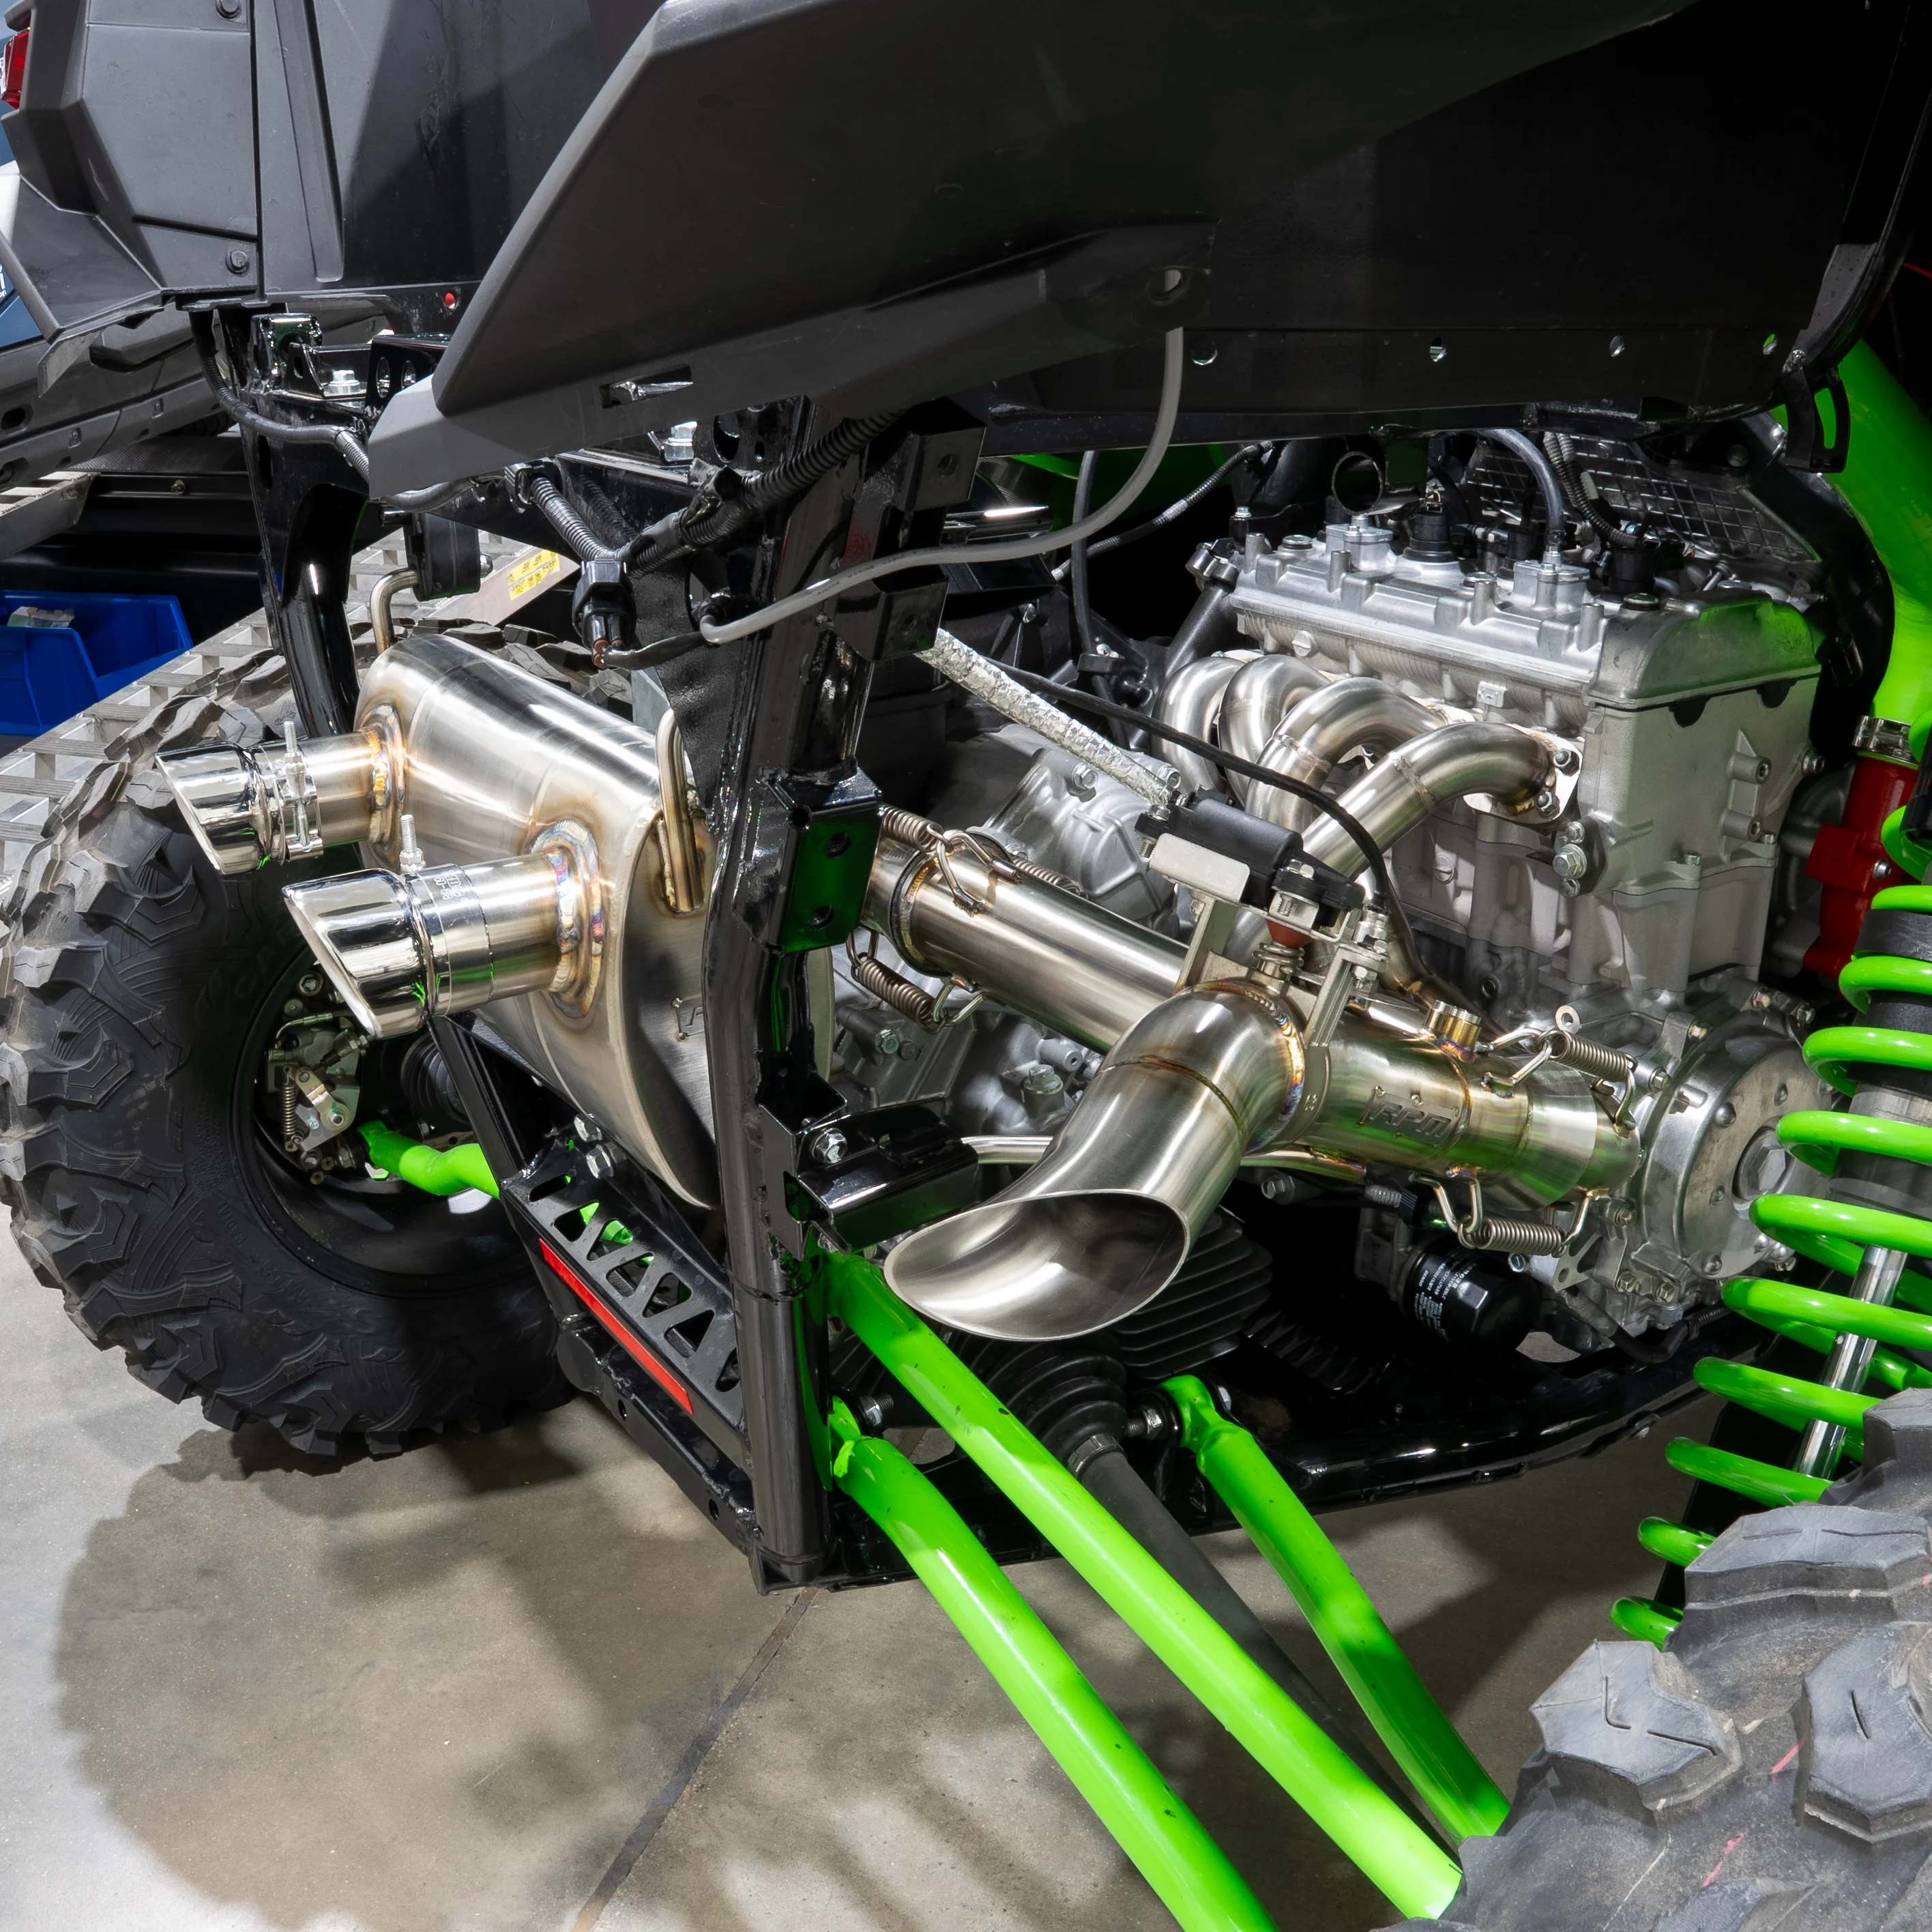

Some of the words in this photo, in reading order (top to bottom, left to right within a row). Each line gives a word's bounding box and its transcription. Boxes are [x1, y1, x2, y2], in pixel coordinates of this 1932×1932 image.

[1369, 1103, 1452, 1138] RPM
[217, 1200, 246, 1247] RADIAL
[1419, 1270, 1429, 1287] DENSO
